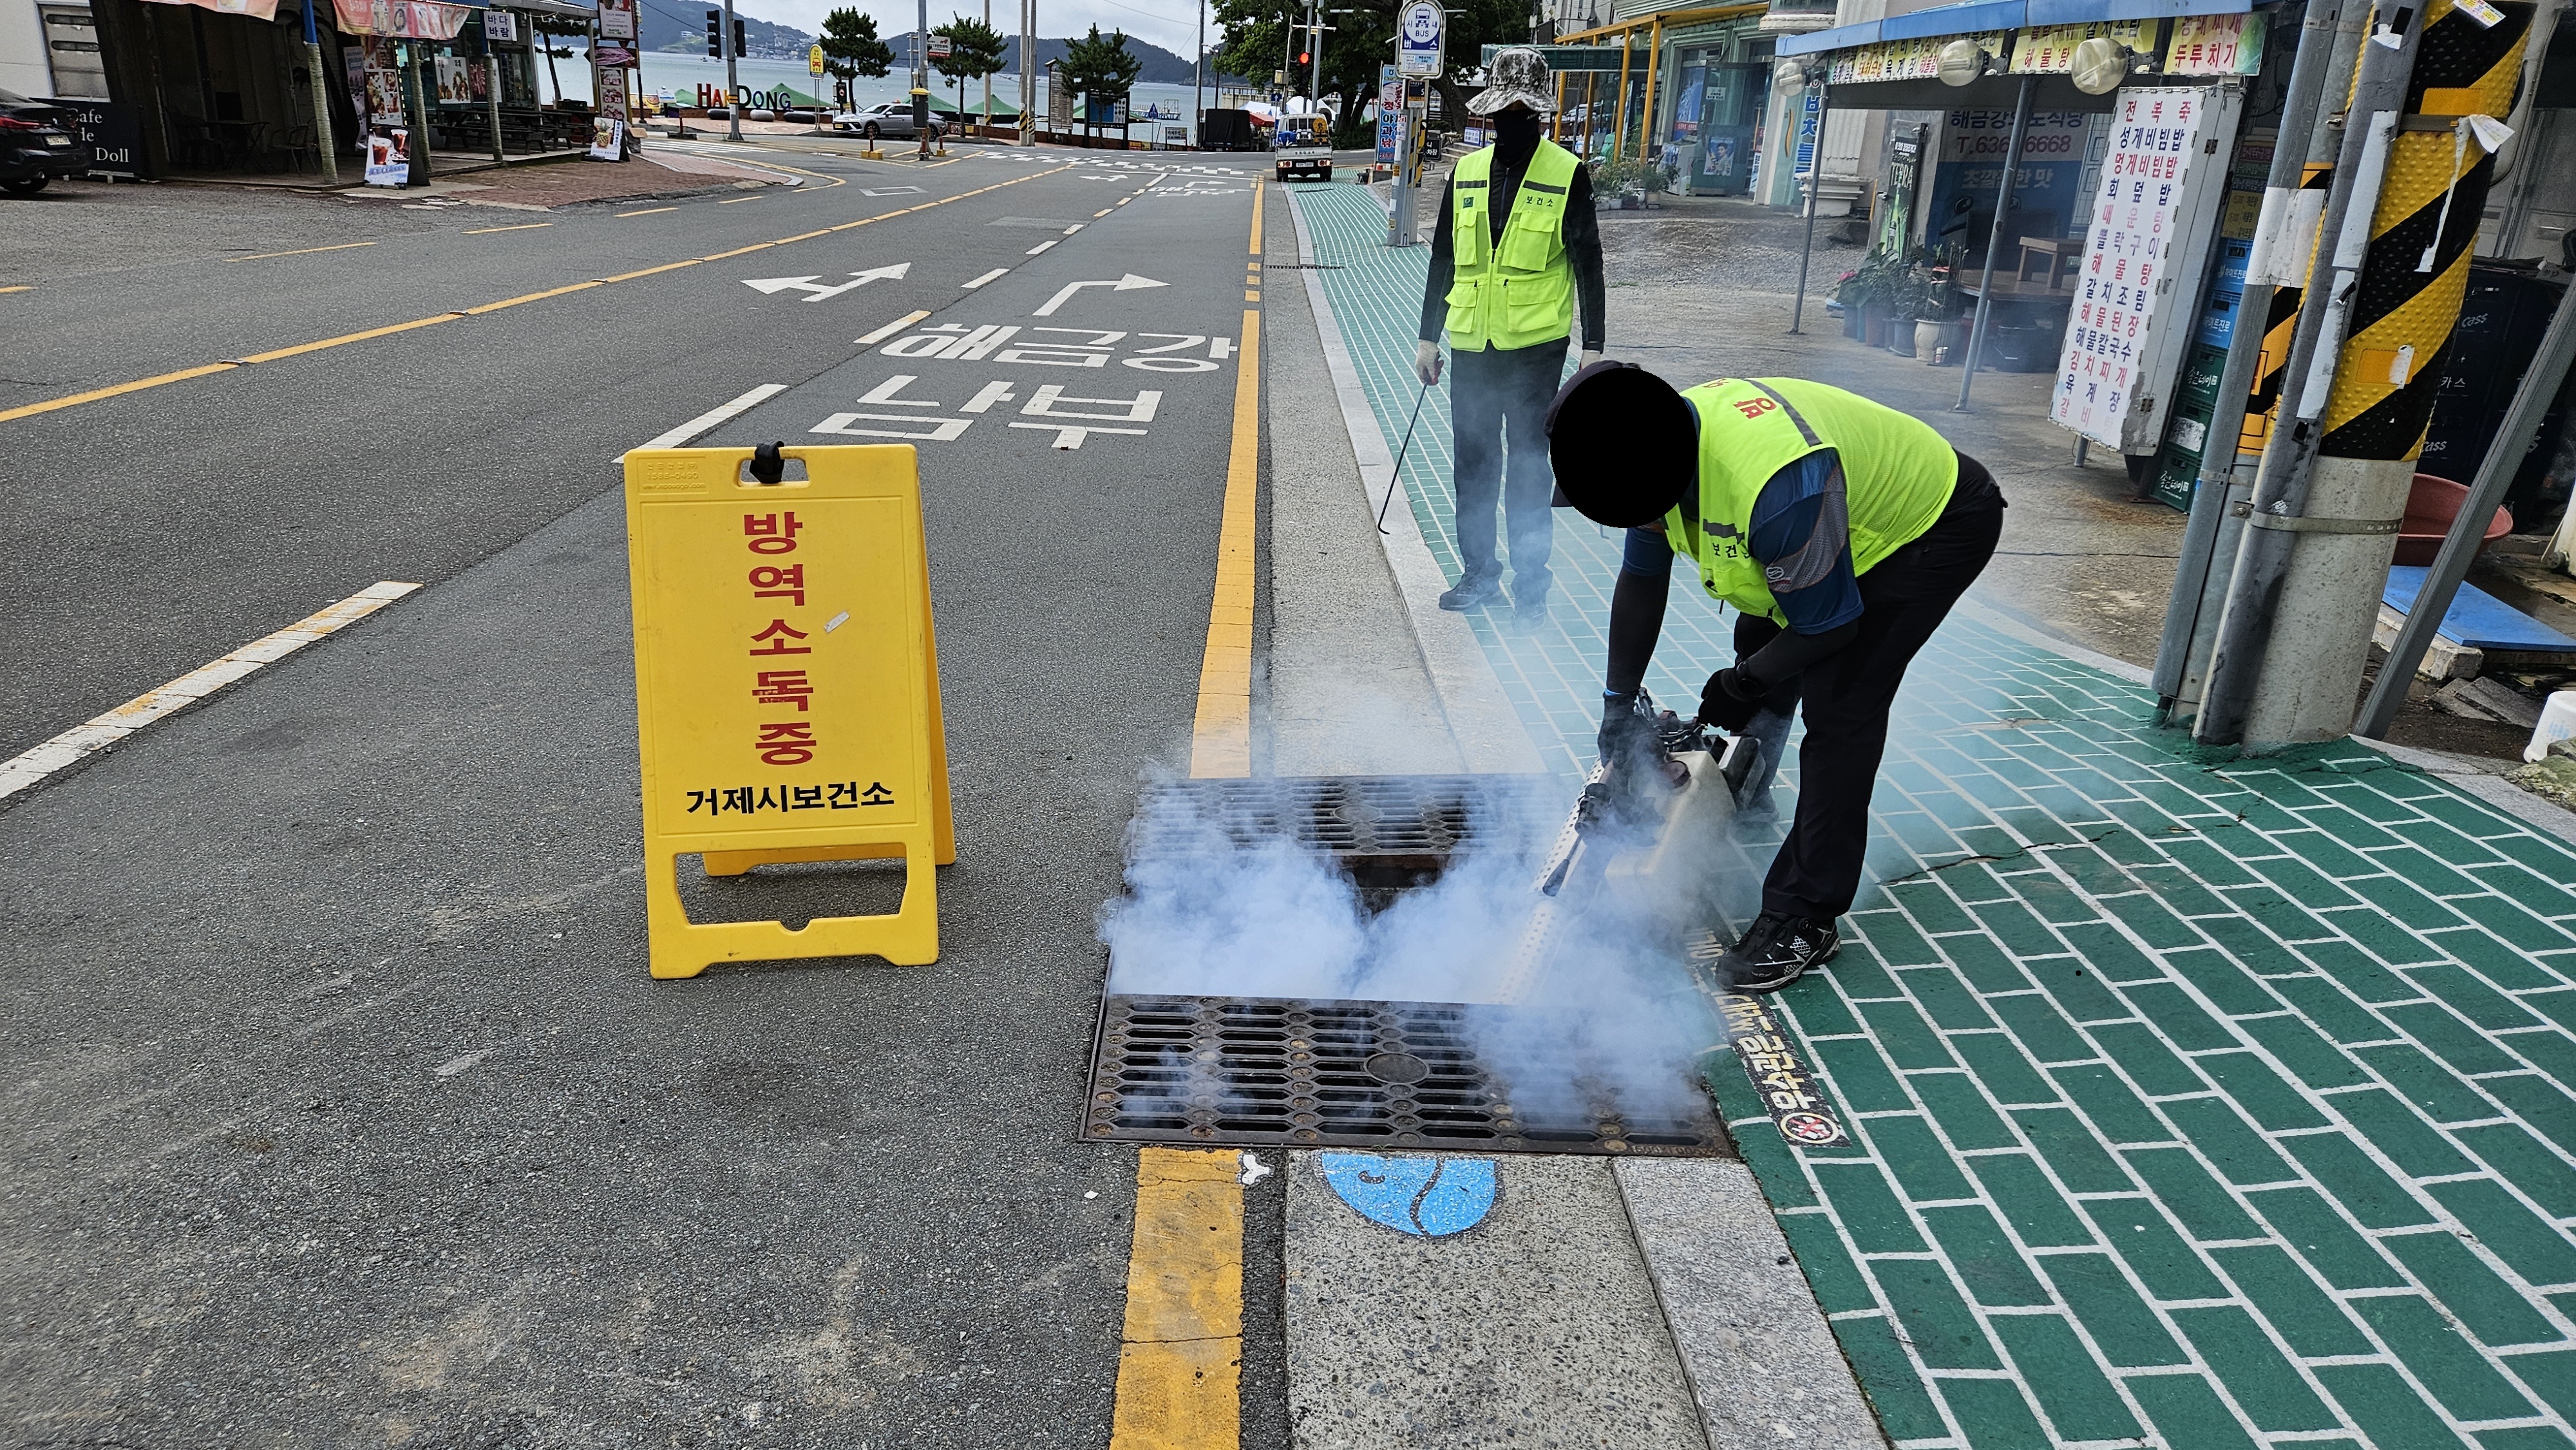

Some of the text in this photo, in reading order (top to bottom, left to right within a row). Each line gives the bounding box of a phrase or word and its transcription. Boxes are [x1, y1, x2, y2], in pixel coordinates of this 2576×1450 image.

[488, 14, 509, 24] 바다
[488, 26, 510, 38] 바람
[1404, 39, 1437, 50] 버스
[2024, 46, 2070, 68] 해물탕
[2174, 42, 2239, 68] 두루치기
[2126, 100, 2191, 124] 전복죽
[1957, 135, 2071, 154] T.6366668
[2120, 126, 2185, 151] 성게비빔밥
[95, 147, 129, 162] Doll
[2114, 153, 2178, 179] 멍게비빔밥
[1526, 195, 1553, 207] 보건소
[2107, 178, 2172, 206] 회덮밥
[2092, 253, 2152, 286] 해물탕
[2087, 278, 2146, 312] 갈치조림
[2081, 302, 2139, 337] 해물된장
[879, 323, 1238, 372] 해금강
[2076, 326, 2132, 362] 해물칼국수
[2070, 350, 2128, 389] 김치찌개
[2440, 377, 2465, 388] 카스
[808, 375, 1163, 449] 남부
[743, 511, 817, 766] 방역소독중
[687, 781, 895, 816] 거제시보건소
